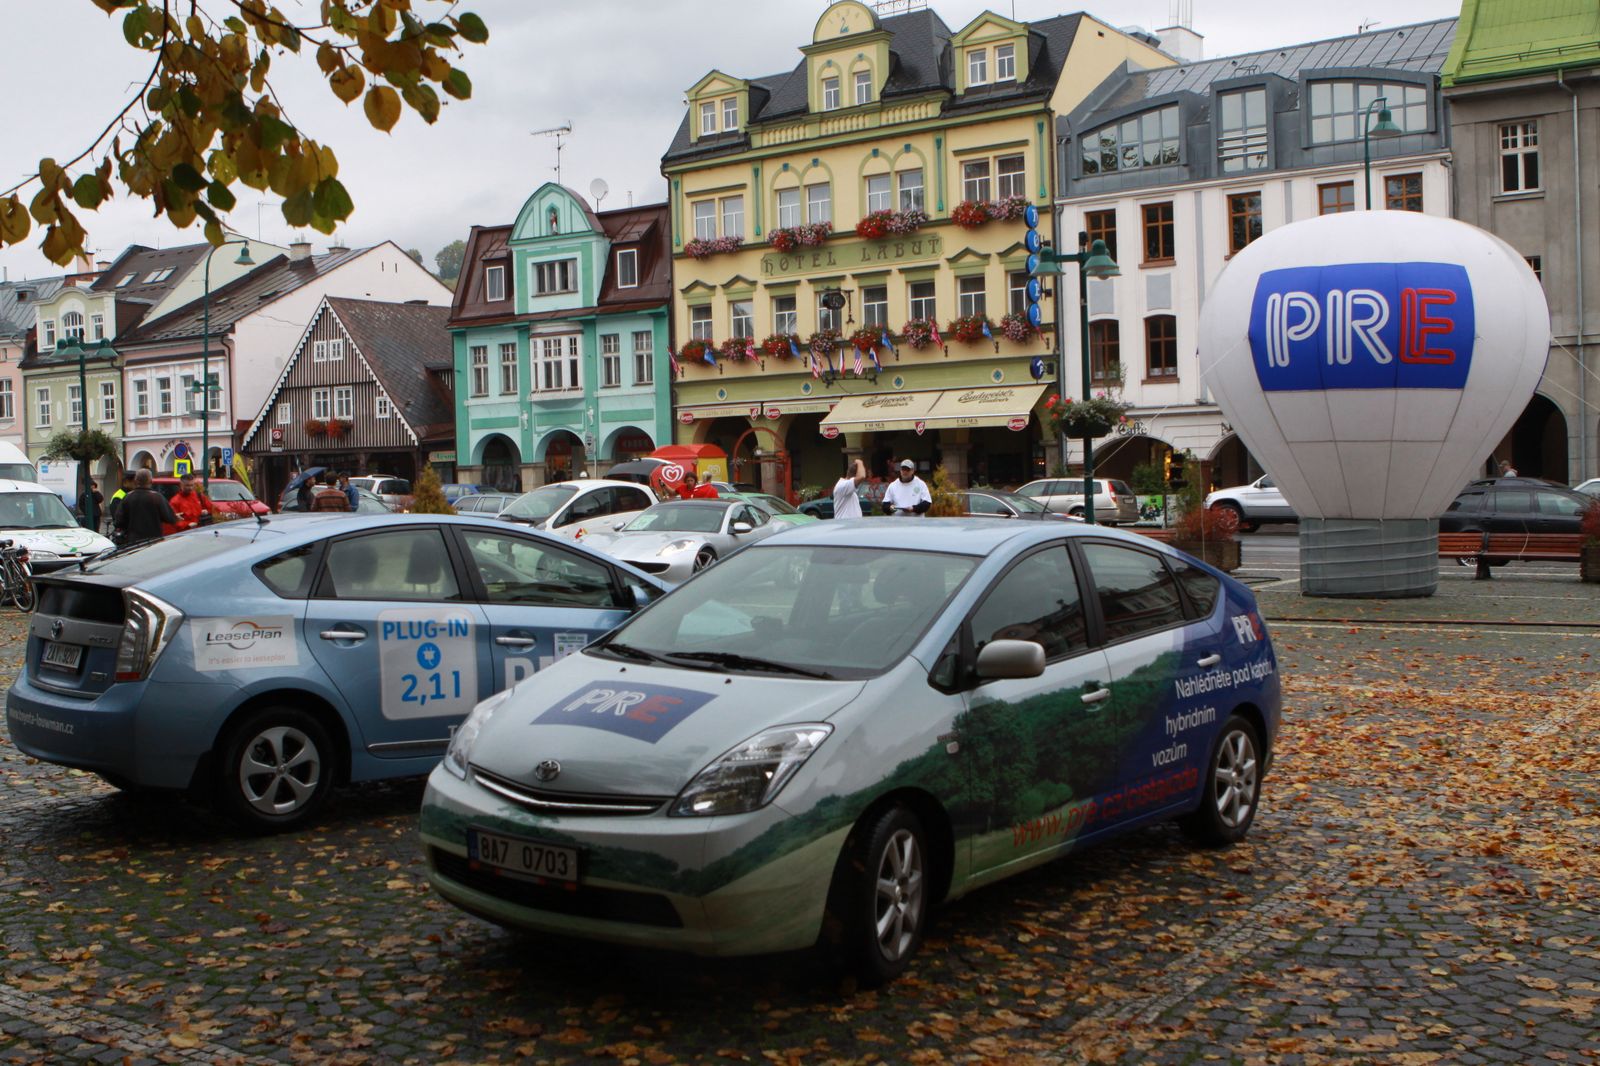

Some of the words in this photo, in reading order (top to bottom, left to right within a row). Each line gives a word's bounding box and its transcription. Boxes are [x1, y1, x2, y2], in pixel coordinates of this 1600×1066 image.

[764, 252, 836, 275] HOTEL
[1266, 287, 1457, 368] PRE
[206, 630, 282, 642] LeasePlan
[383, 618, 469, 641] PLUG-IN
[1233, 663, 1250, 688] pod
[562, 689, 684, 724] PRE
[1166, 705, 1216, 738] hybridním
[1152, 742, 1187, 767] vozům
[480, 837, 509, 864] 8A7
[522, 845, 568, 876] 0703
